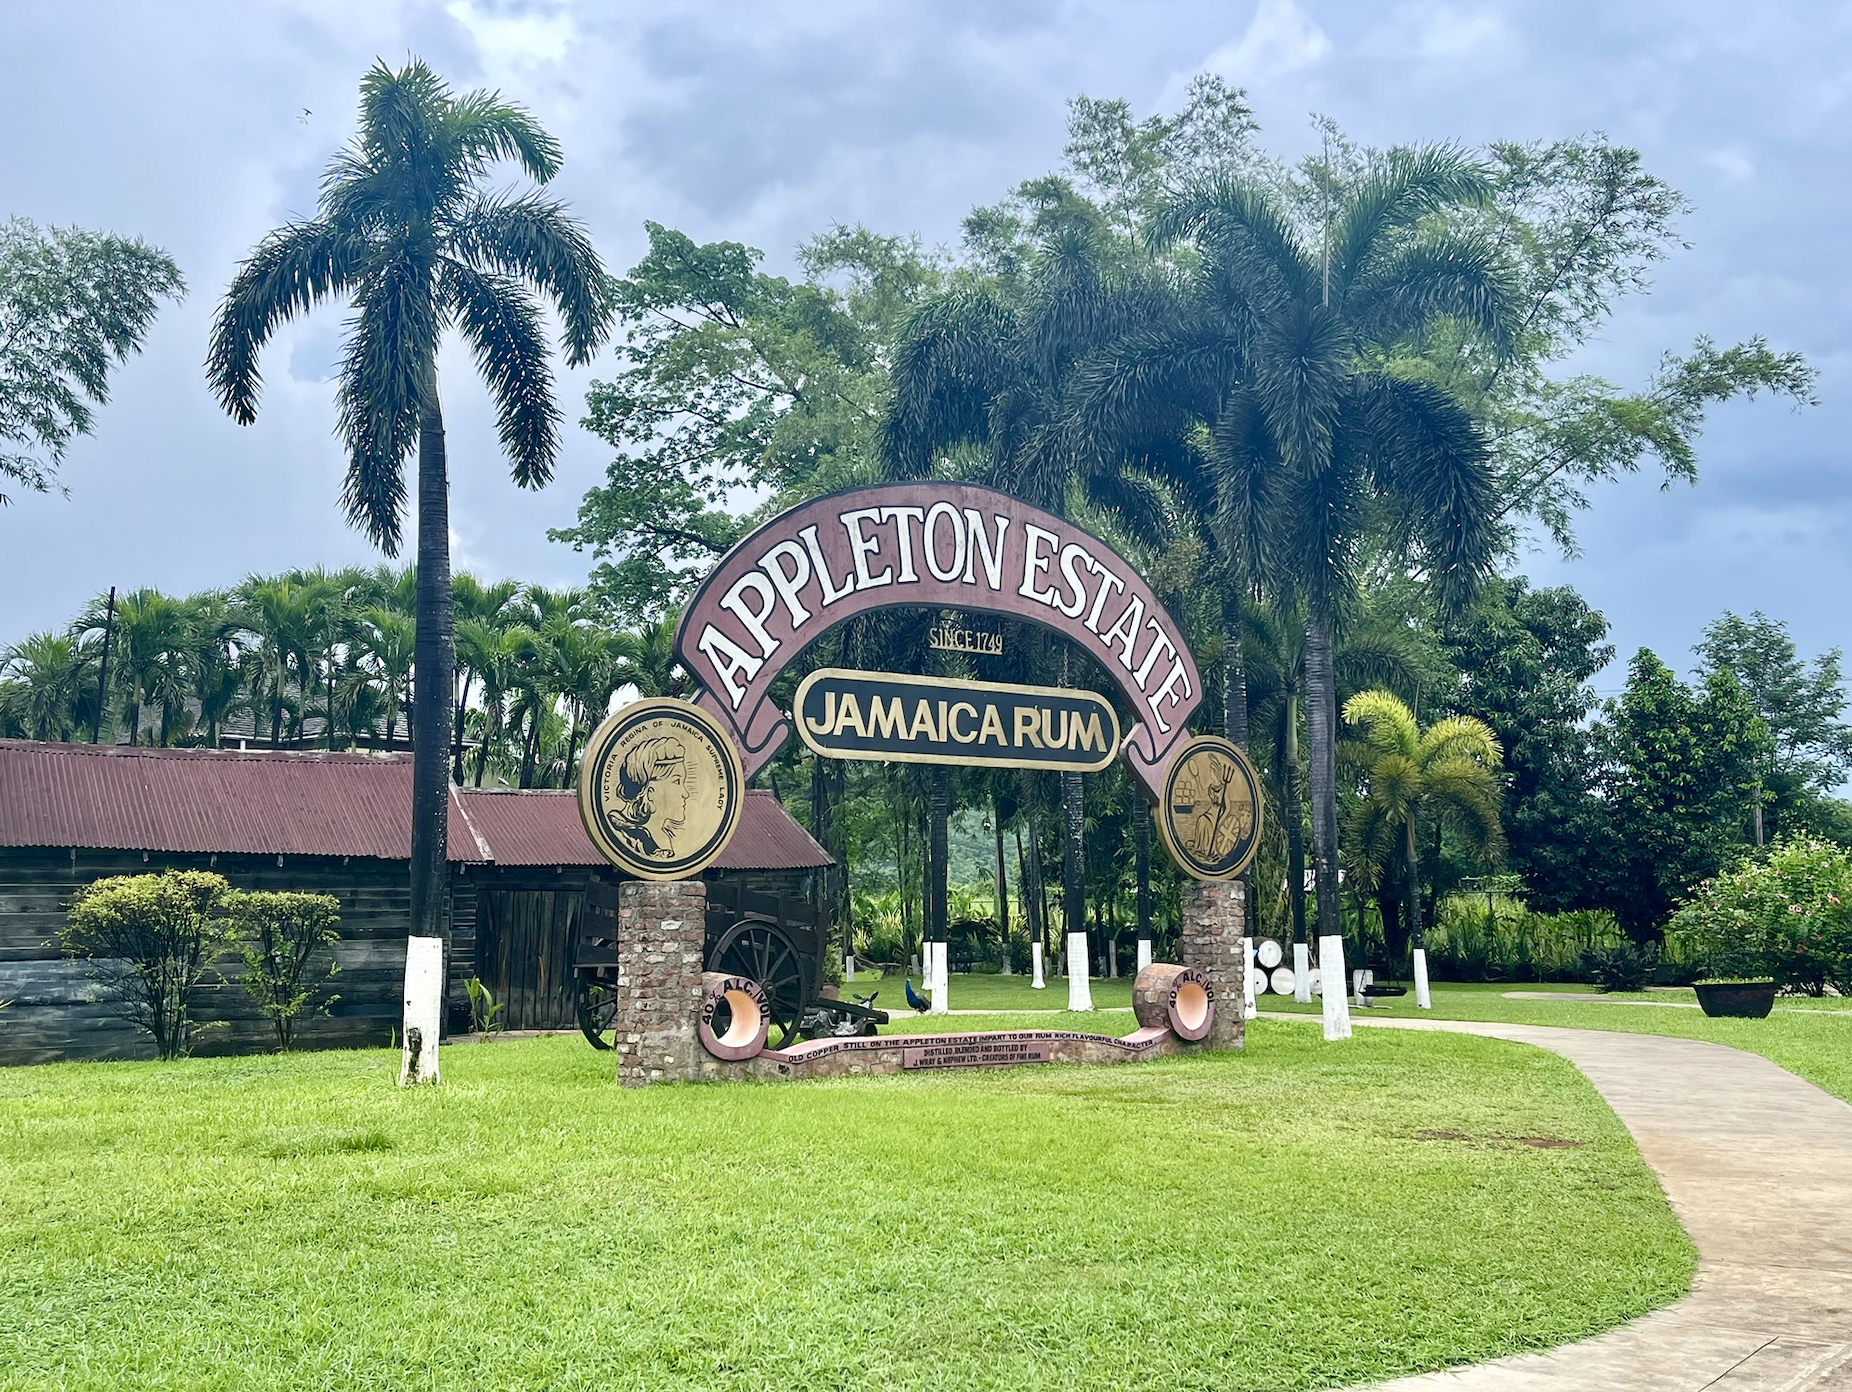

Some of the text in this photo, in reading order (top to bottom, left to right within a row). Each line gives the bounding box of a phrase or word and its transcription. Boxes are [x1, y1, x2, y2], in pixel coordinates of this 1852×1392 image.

[698, 501, 1194, 733] APPLETON ESTATE
[929, 628, 1003, 652] SINCE 1749
[806, 691, 1107, 753] JAMAICA RUM
[604, 753, 619, 802] VICTORIA
[620, 725, 648, 748] REGINA
[670, 721, 704, 743] JAMAICA
[705, 744, 724, 780] SUPREME
[717, 786, 726, 811] LADY
[702, 990, 721, 1025] 40%
[806, 1045, 839, 1059] COPPER
[843, 1041, 867, 1049] STILL
[902, 1037, 947, 1046] APPLETON
[948, 1035, 978, 1044] ESTATE
[979, 1033, 1006, 1042] IMPART
[1072, 1033, 1113, 1044] FLAVOURFUL
[920, 1058, 936, 1066] WRAY
[937, 1057, 942, 1065] &
[943, 1056, 966, 1064] NEPHEW
[982, 1054, 1009, 1062] CREATORS
[1028, 1052, 1041, 1060] RUM
[924, 1043, 1029, 1057] DISTILLED, BLENDED AND BOTTLED BY
